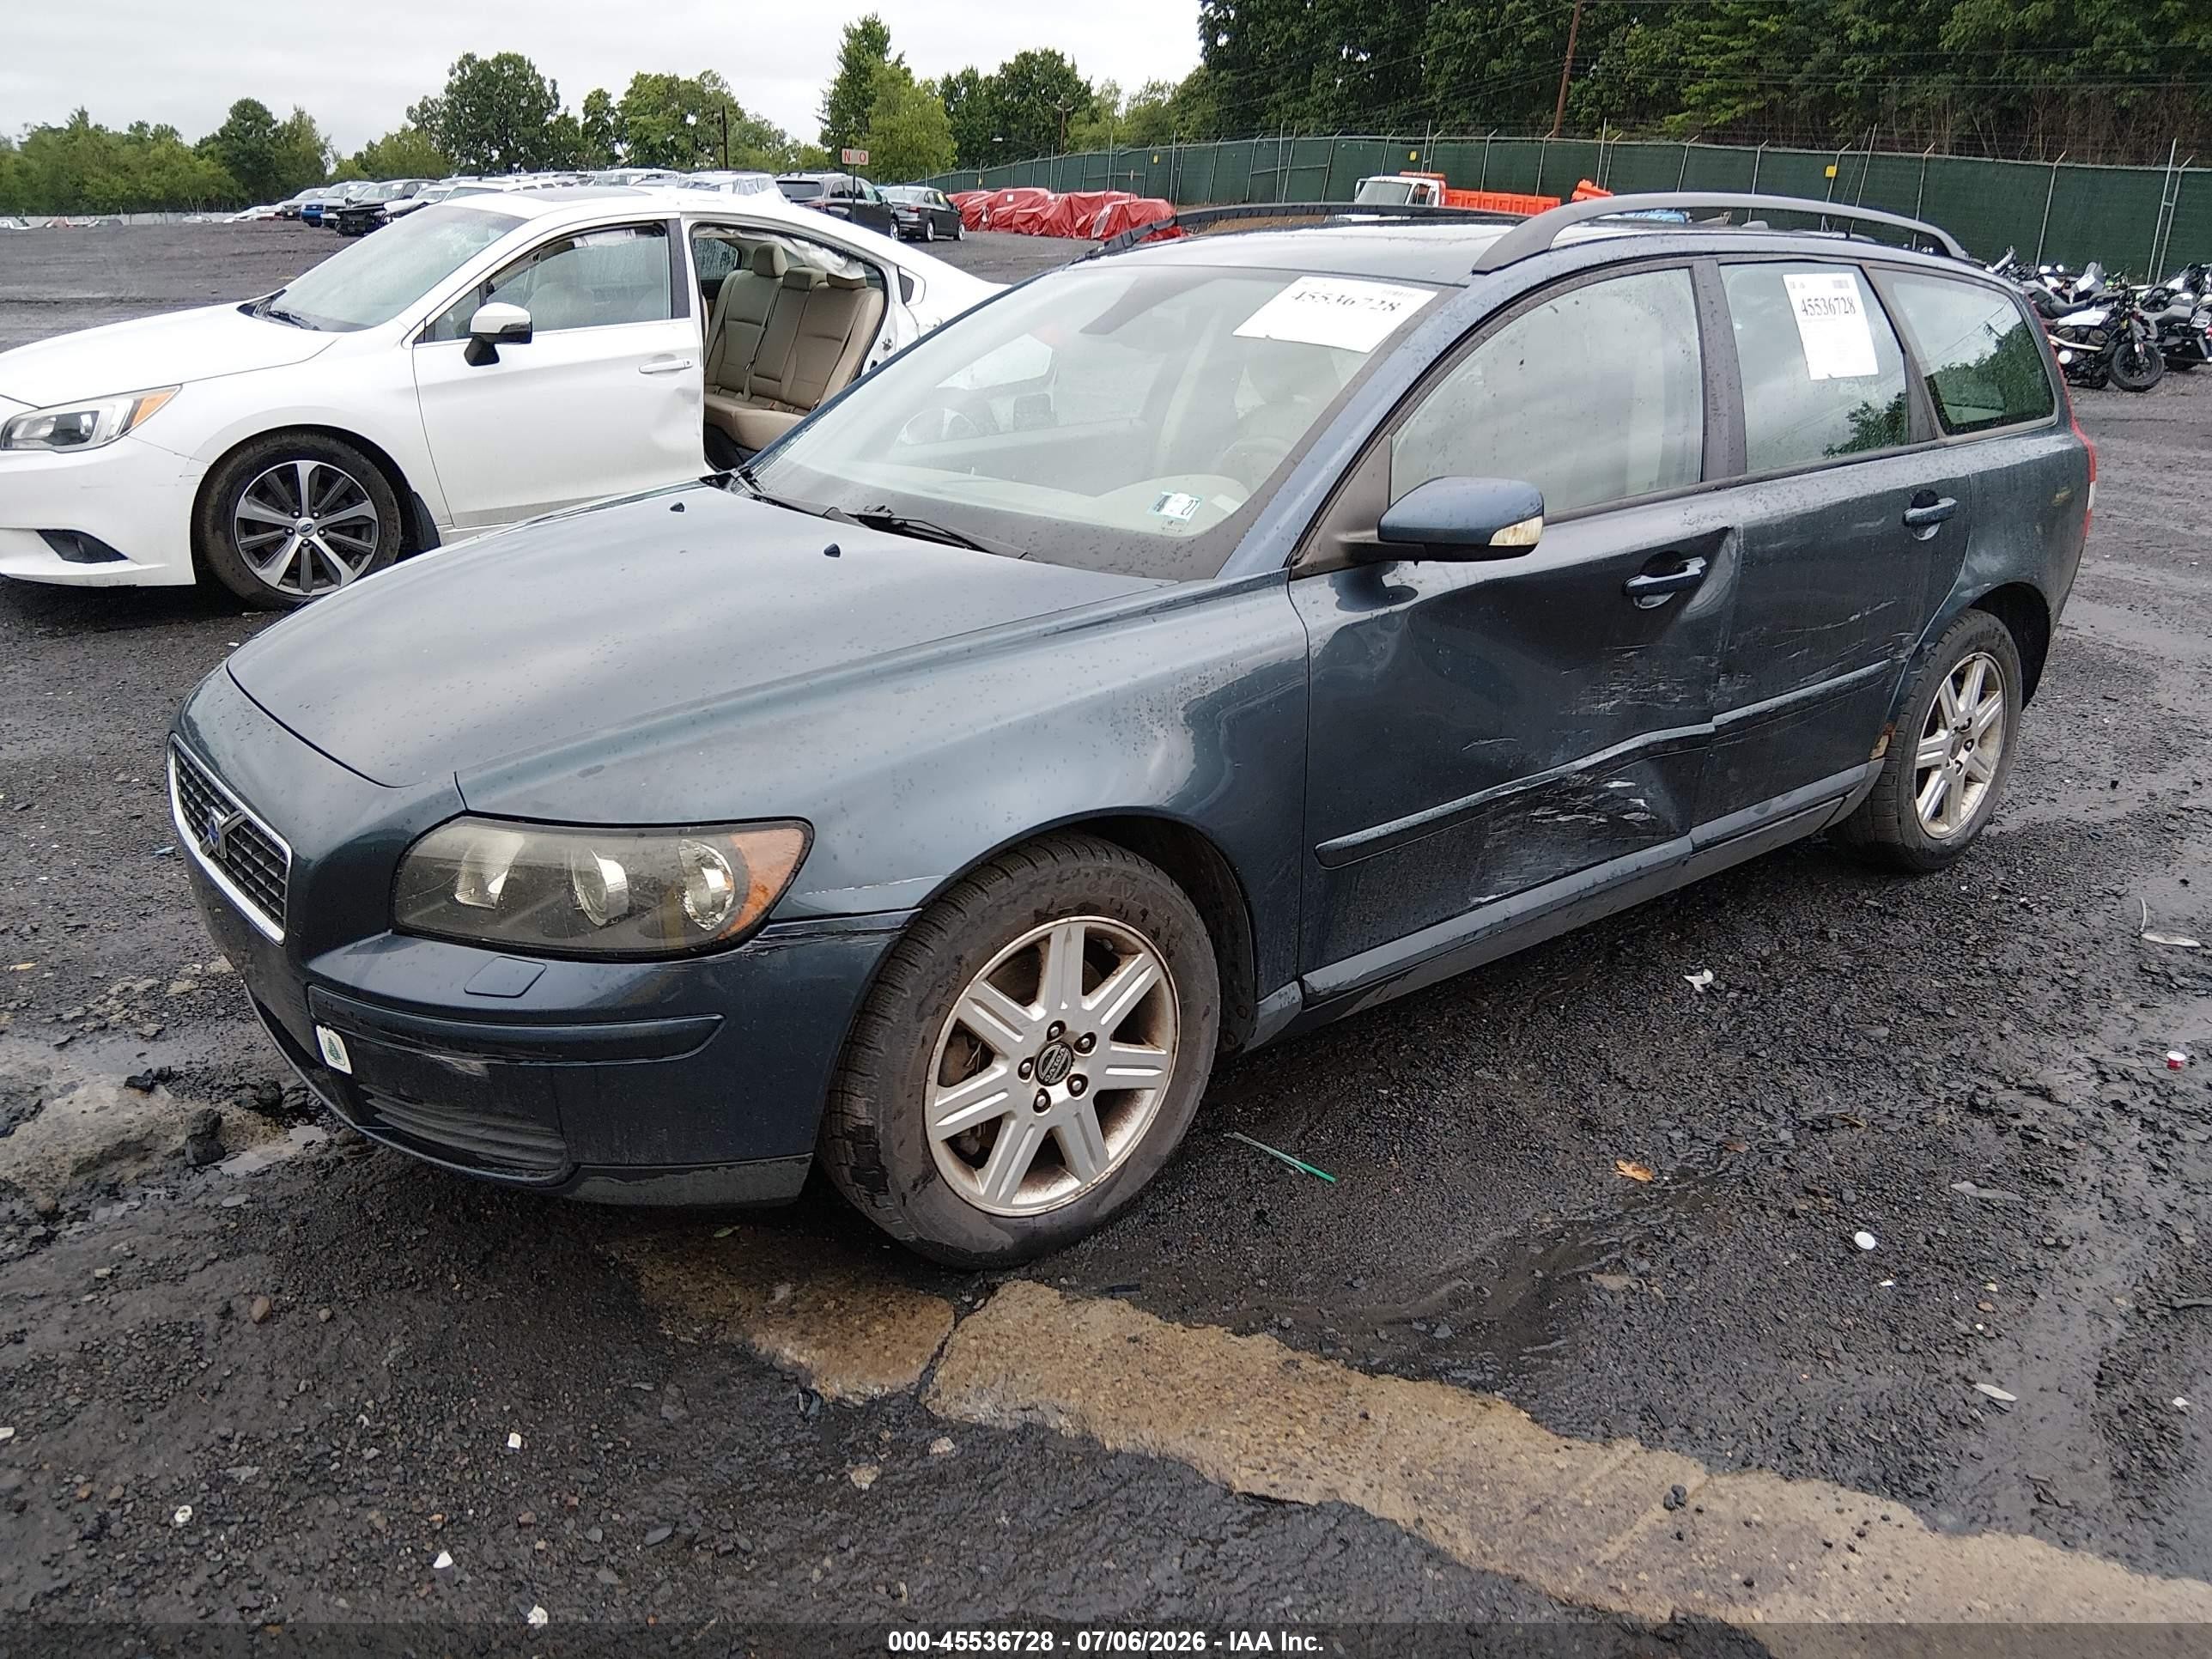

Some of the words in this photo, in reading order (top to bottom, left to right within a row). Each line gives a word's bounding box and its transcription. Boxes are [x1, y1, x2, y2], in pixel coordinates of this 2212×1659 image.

[1291, 290, 1401, 312] 45536728
[1801, 296, 1856, 316] 45536728
[1044, 1047, 1066, 1082] VOLVO
